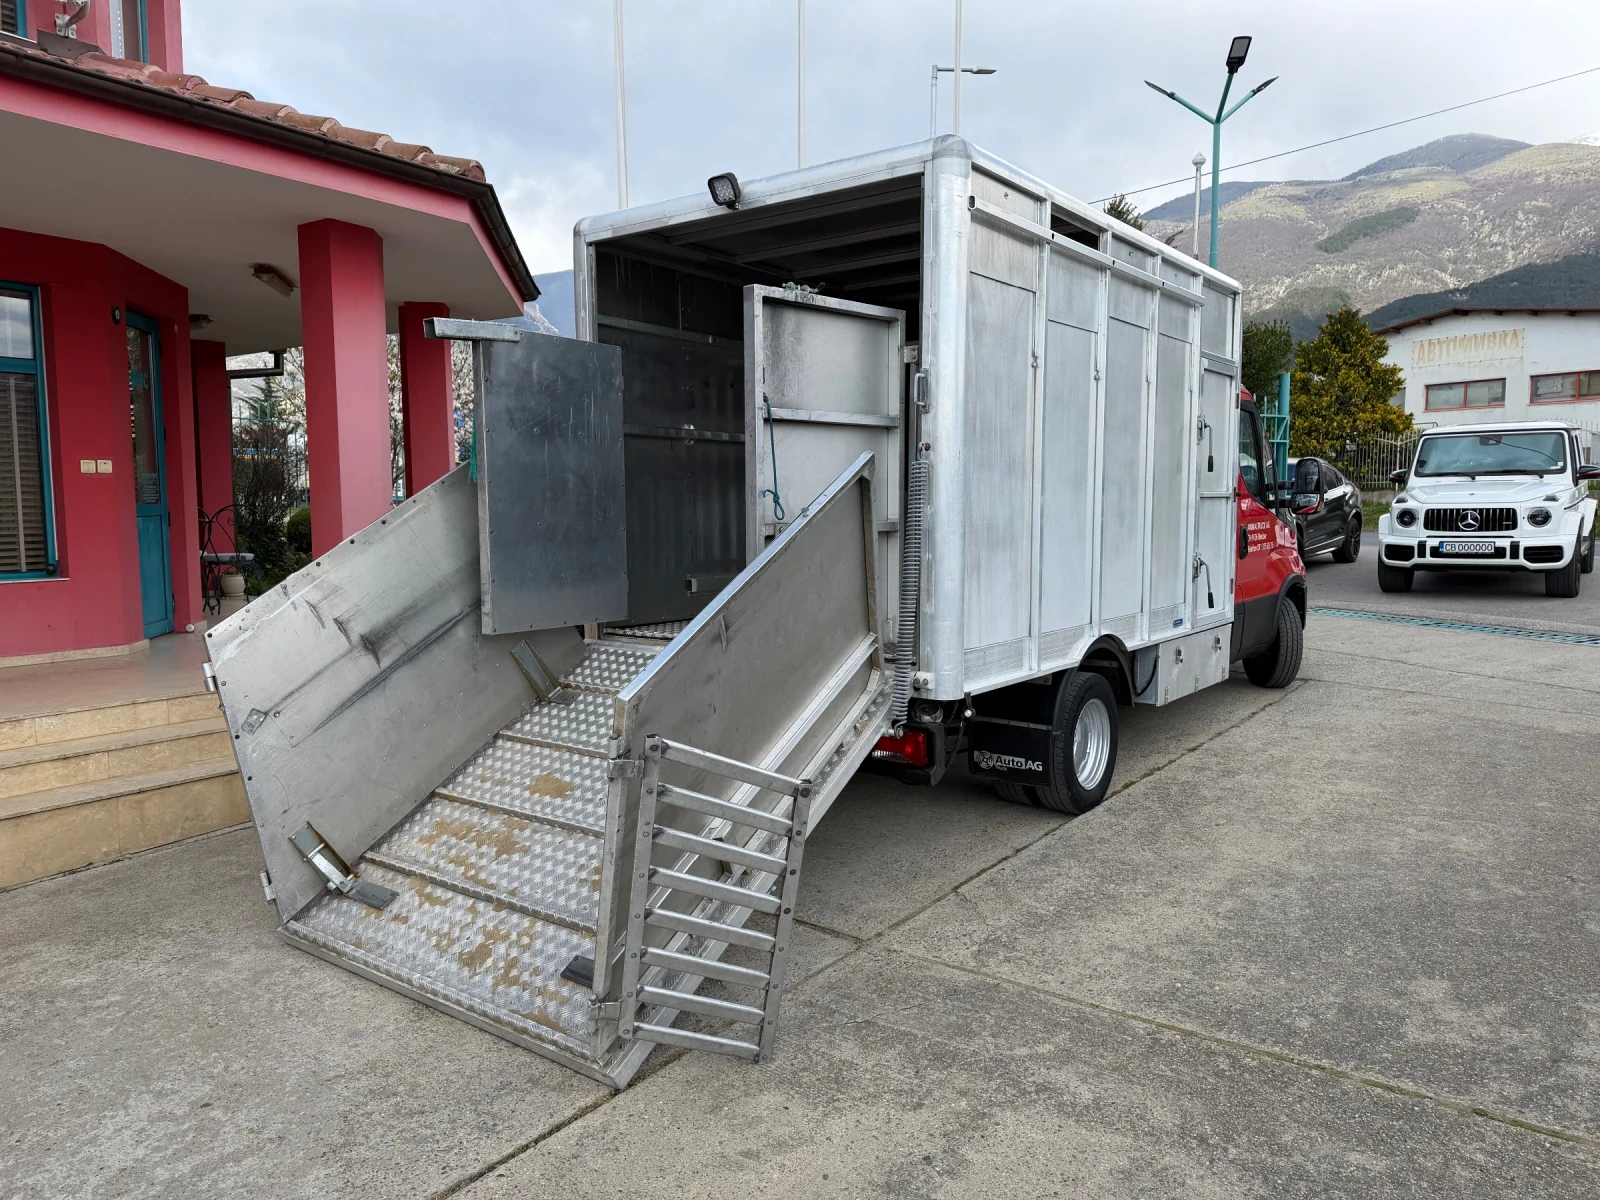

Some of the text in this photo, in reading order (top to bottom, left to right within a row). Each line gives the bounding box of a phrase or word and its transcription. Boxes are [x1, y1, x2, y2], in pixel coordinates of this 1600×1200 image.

[1416, 331, 1520, 366] АВТОМИВКА
[994, 755, 1043, 772] Auto AG
